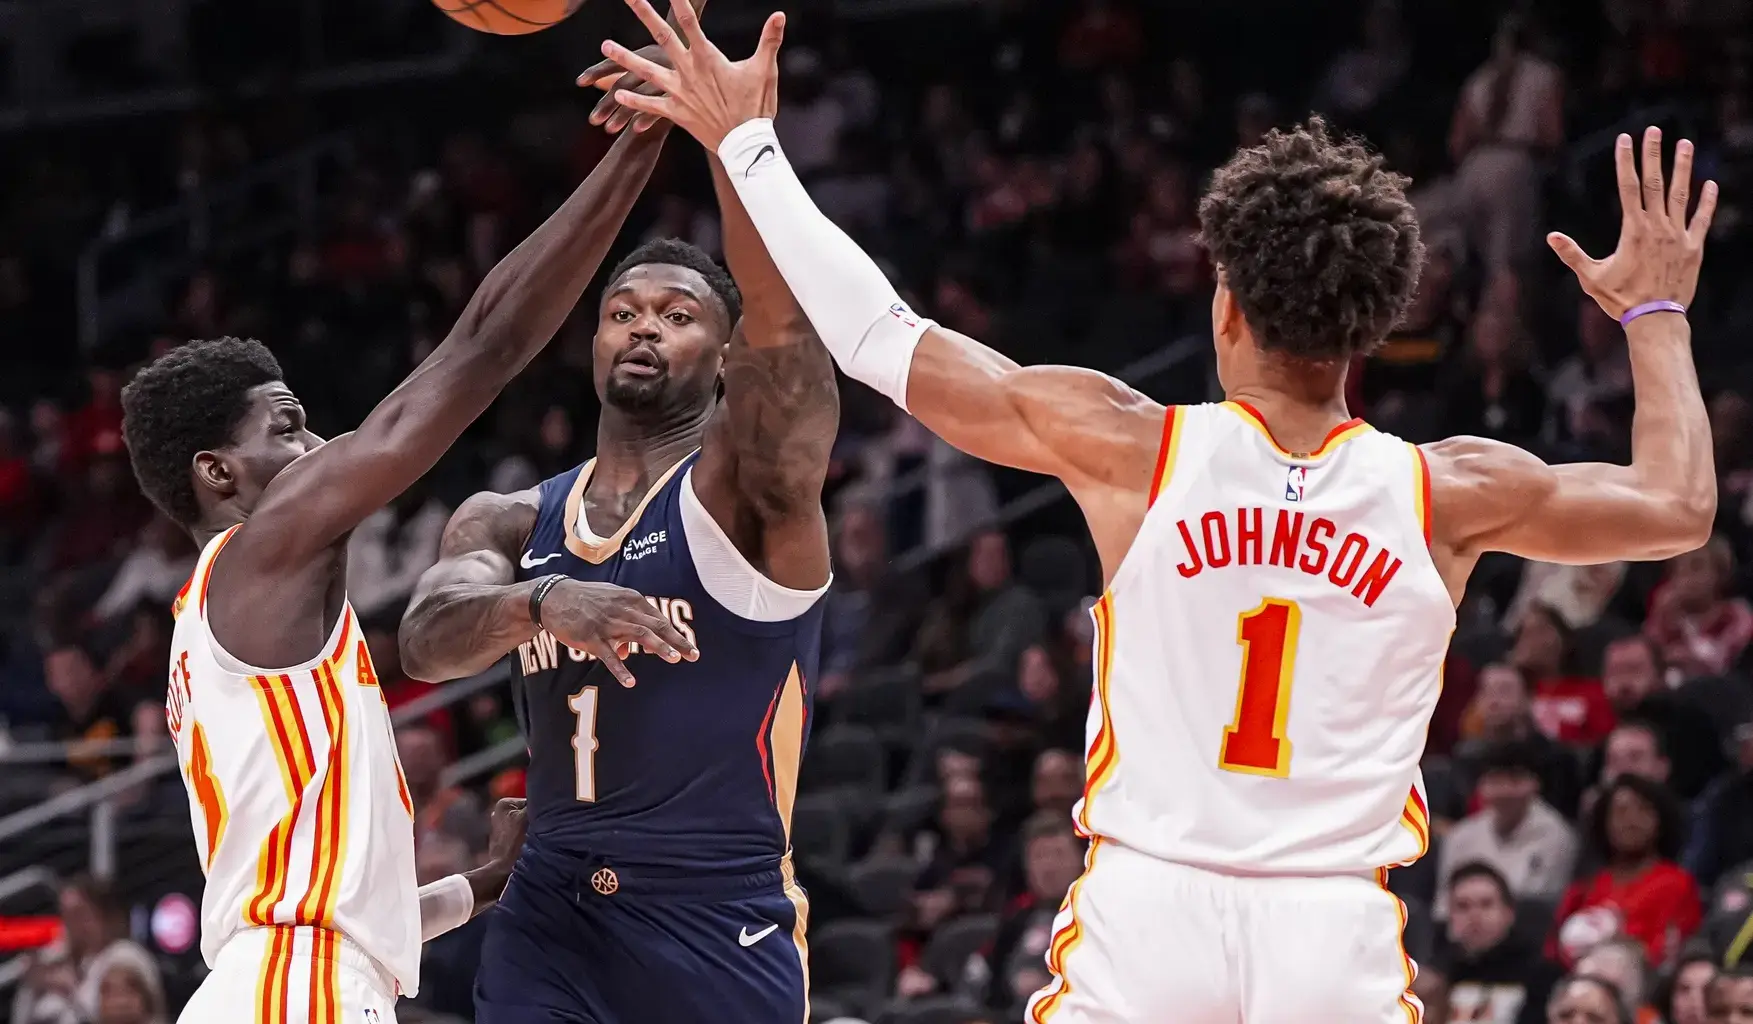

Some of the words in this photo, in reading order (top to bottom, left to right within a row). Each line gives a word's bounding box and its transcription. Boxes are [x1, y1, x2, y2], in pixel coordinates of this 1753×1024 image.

[1175, 507, 1403, 608] JOHNSON
[517, 628, 559, 677] NEW
[1218, 596, 1302, 779] 1
[567, 685, 599, 803] 1
